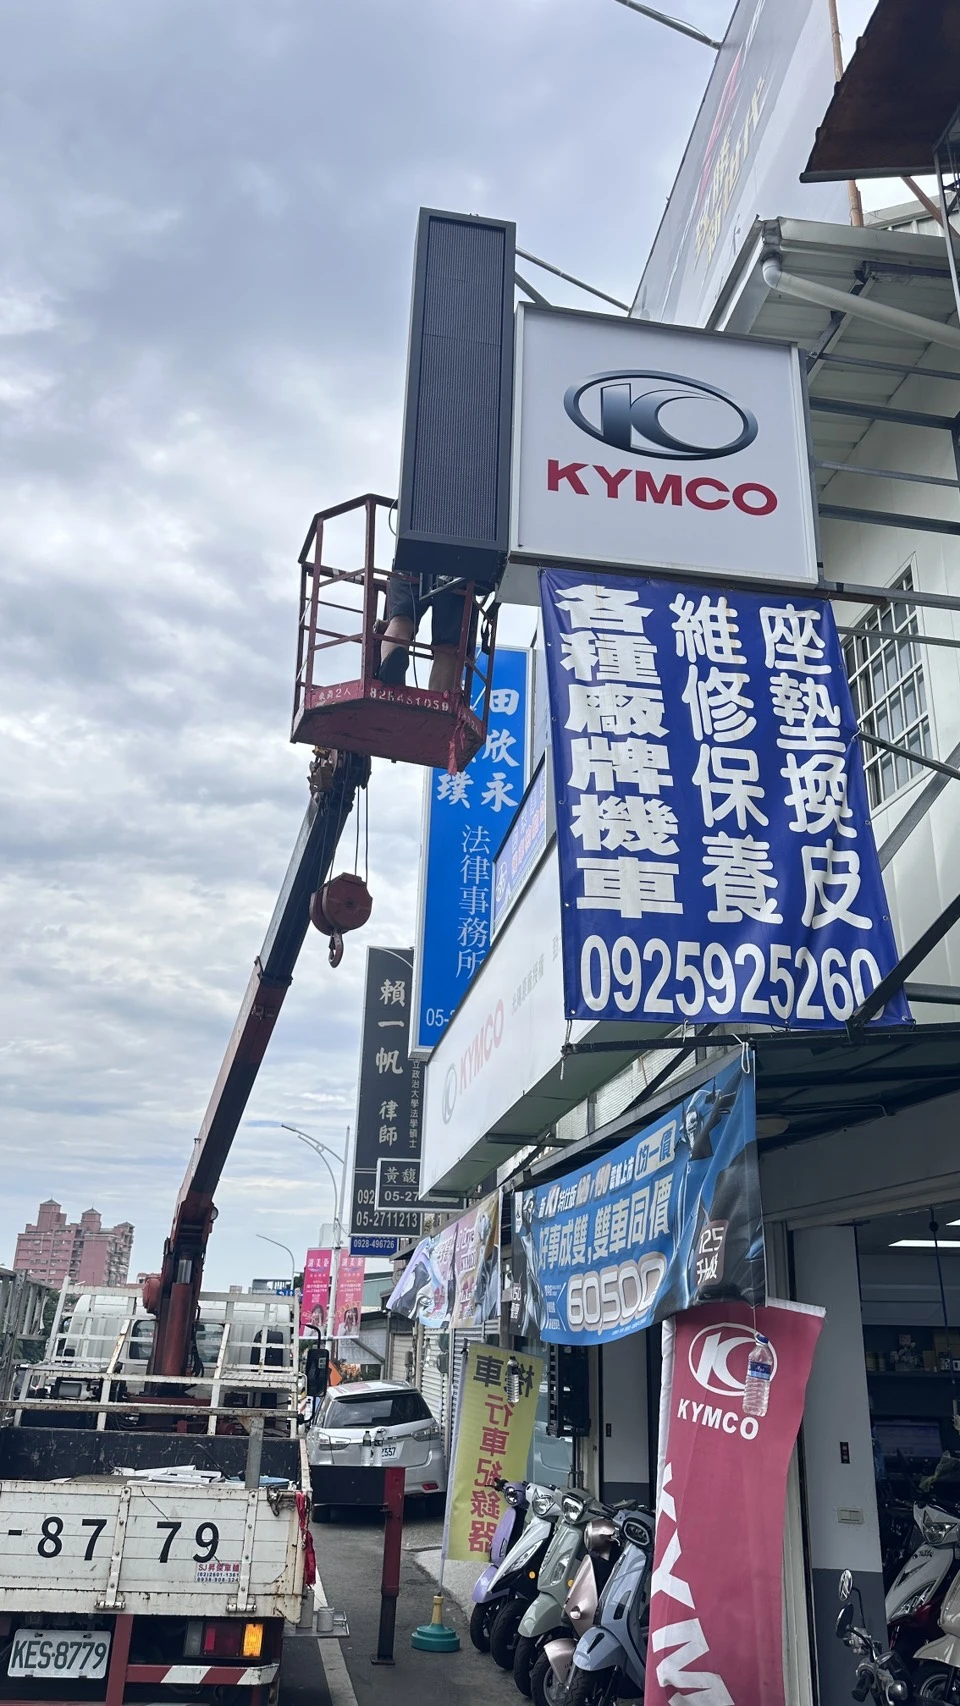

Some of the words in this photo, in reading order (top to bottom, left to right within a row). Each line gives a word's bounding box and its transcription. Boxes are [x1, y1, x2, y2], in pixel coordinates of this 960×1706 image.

[547, 459, 778, 516] KYMCO
[481, 688, 521, 812] 田欣永
[555, 584, 683, 918] 各種廠牌機車
[669, 593, 783, 924] 維修保養
[759, 603, 873, 930] 座墊換皮
[456, 825, 491, 980] 法律事務所
[580, 934, 882, 1023] 0925925260
[376, 978, 406, 1075] 賴一帆
[459, 999, 504, 1095] KYMCO
[378, 1099, 399, 1147] 律師
[353, 1239, 395, 1249] 0928-496726
[356, 1211, 418, 1228] 05-2711213
[677, 1398, 759, 1441] KYMCO
[12, 1640, 107, 1670] KES-8779
